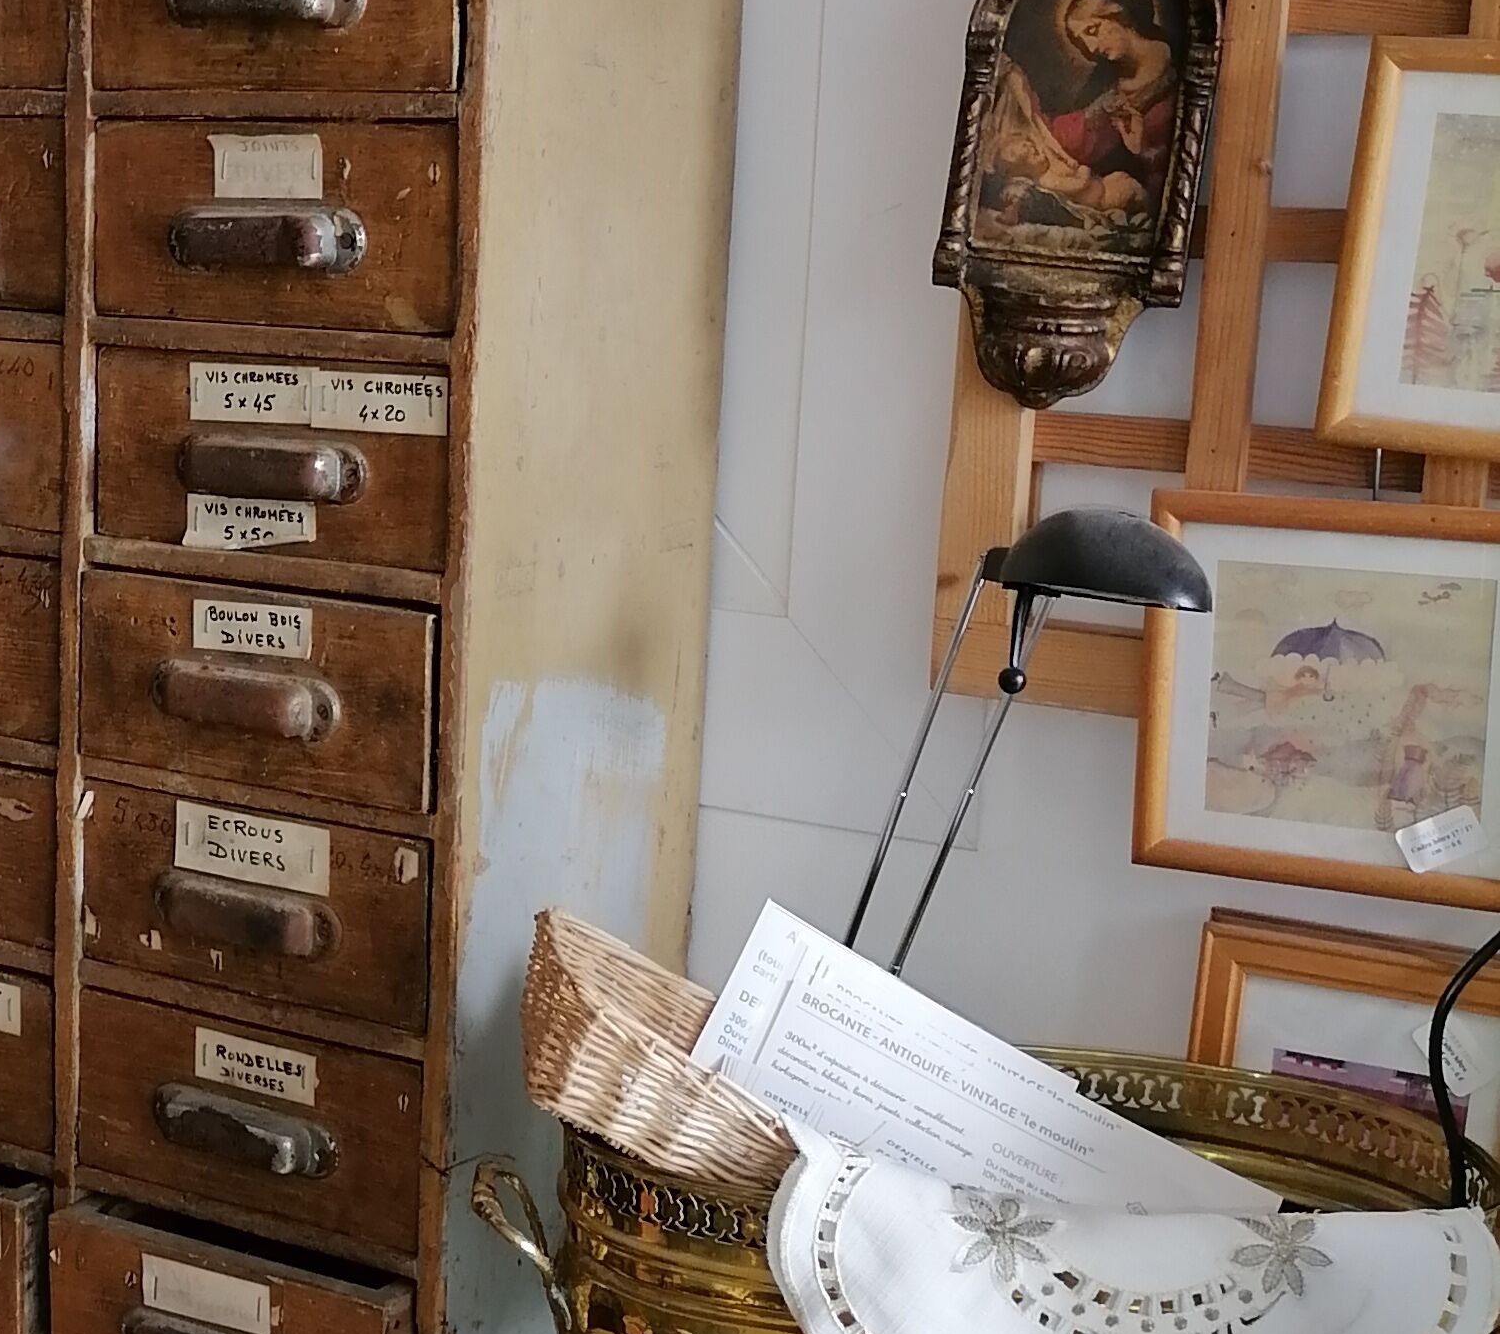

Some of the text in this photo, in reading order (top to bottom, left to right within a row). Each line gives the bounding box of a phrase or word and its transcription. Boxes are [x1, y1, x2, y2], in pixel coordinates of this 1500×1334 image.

[204, 370, 228, 385] VIS
[330, 378, 354, 392] VIS
[223, 393, 233, 409] 5
[254, 392, 276, 412] 45
[384, 405, 406, 422] 20
[203, 502, 228, 517] VIS
[223, 526, 232, 540] 5
[208, 605, 303, 630] BOULON BOIS
[220, 628, 285, 651] DIVERS
[208, 813, 284, 845] ECROUS
[207, 839, 286, 874] DIVERS
[215, 1044, 303, 1077] RONDELLES
[800, 991, 872, 1040] BROCANTE
[960, 1077, 1019, 1121] VINTAGE
[1038, 1124, 1095, 1157] moulin"
[991, 1142, 1059, 1184] OUVERTURE
